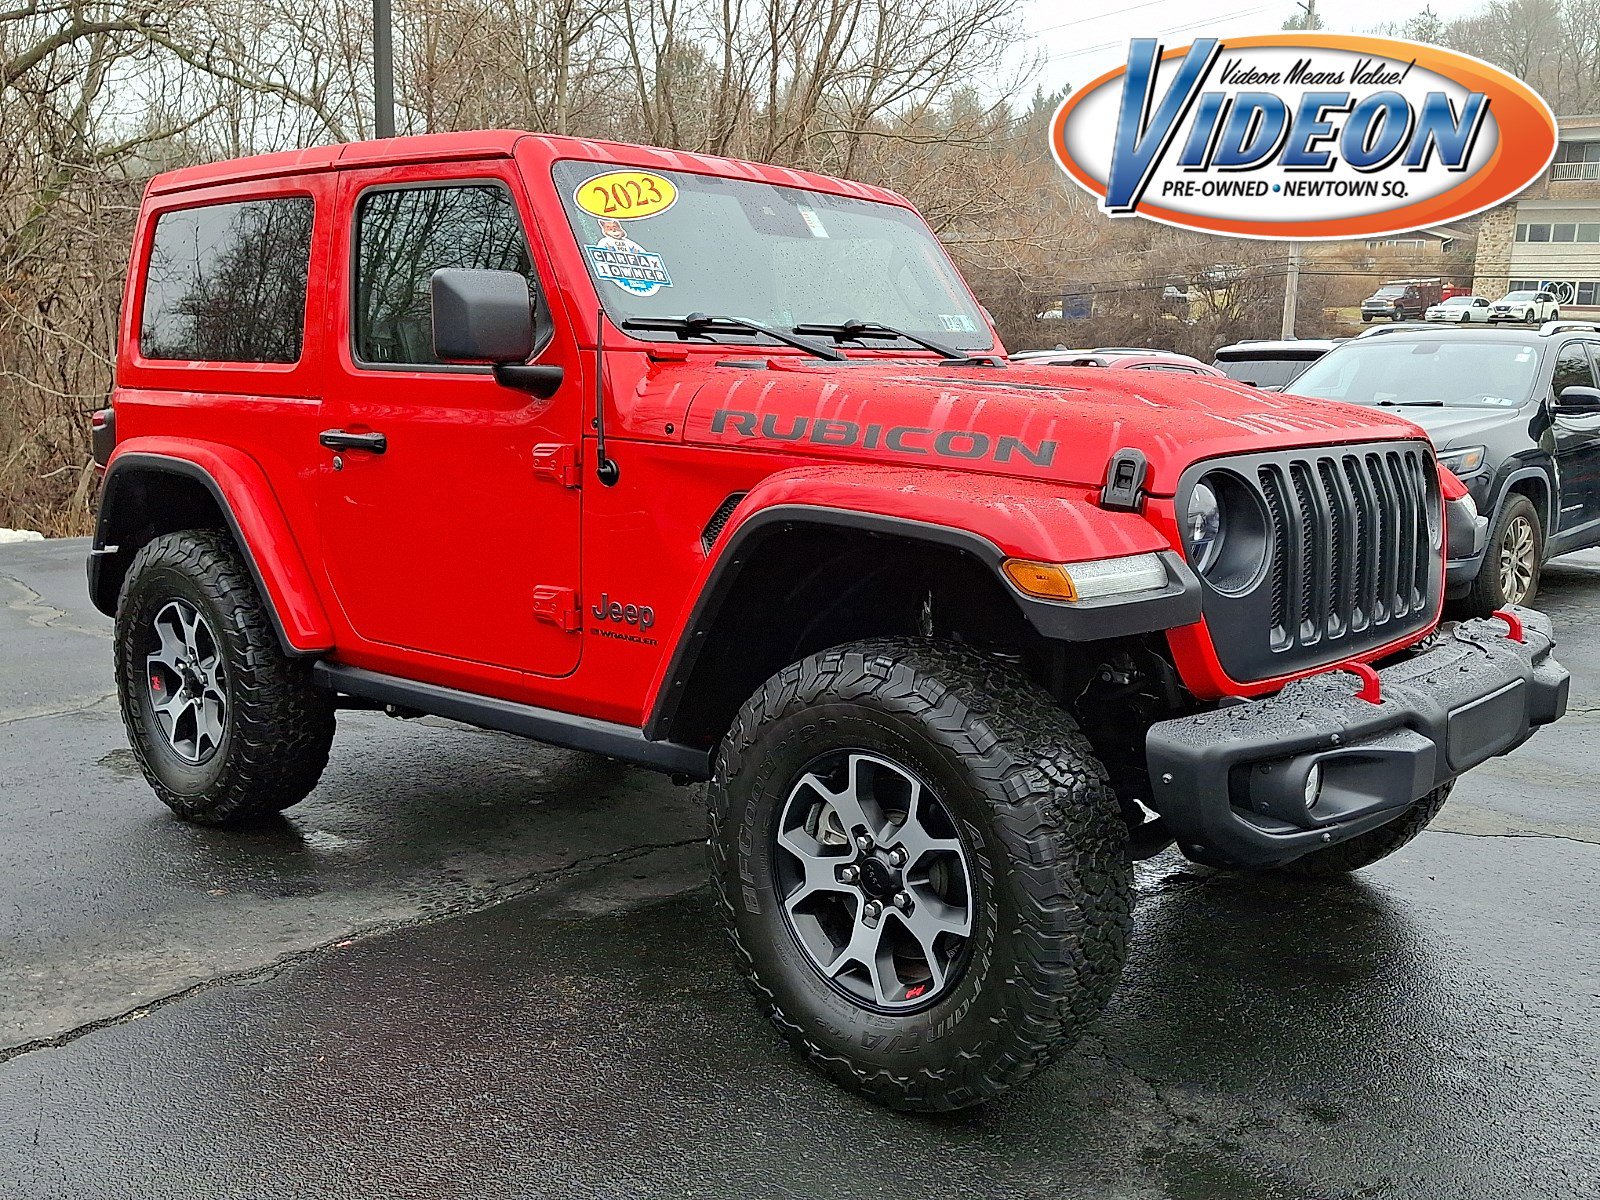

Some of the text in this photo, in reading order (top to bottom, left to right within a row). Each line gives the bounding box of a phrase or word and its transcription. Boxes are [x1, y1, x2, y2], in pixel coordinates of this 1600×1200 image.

[594, 178, 662, 213] 2023
[592, 250, 660, 268] CARFAX
[600, 265, 667, 282] 1 OWNER
[710, 408, 1058, 467] RUBICON
[591, 592, 655, 632] Jeep
